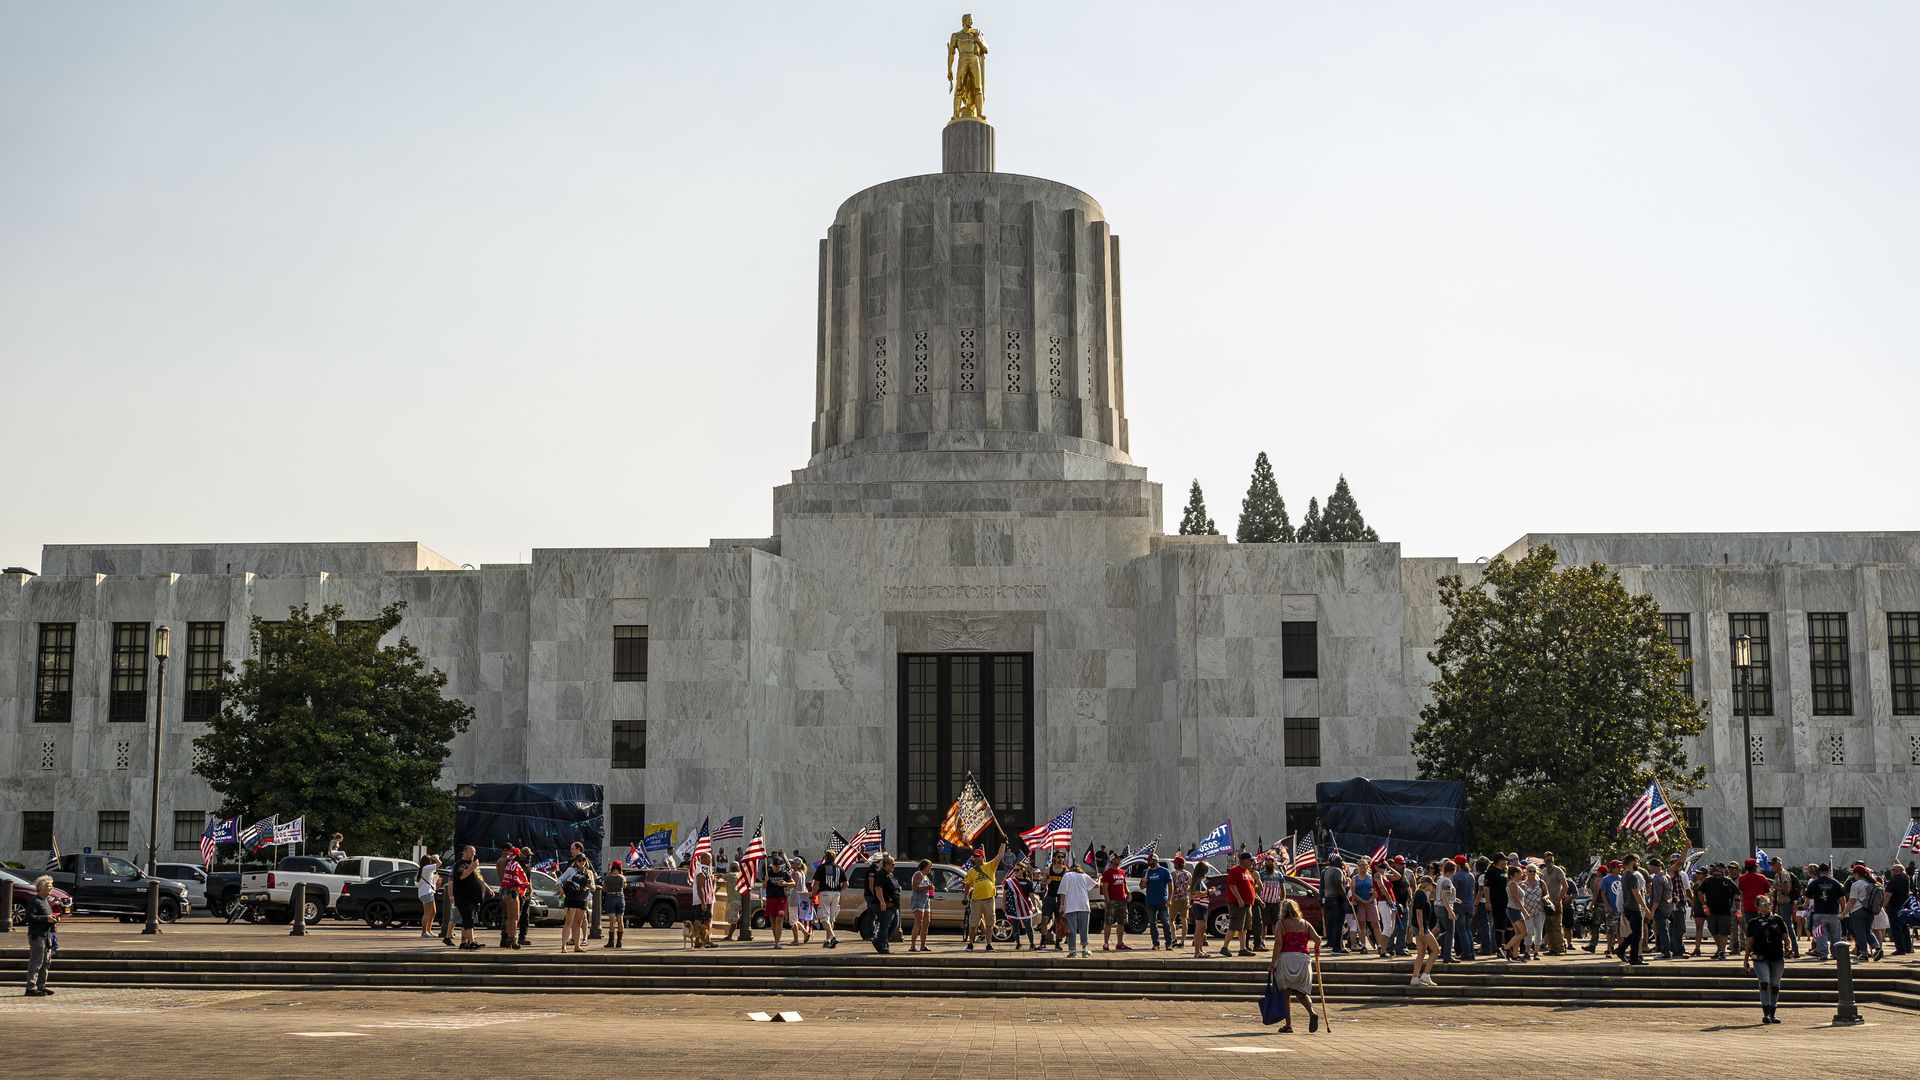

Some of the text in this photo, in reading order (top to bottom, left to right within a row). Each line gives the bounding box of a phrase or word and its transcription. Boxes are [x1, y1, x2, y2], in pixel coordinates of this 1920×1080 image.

[884, 585, 1047, 600] STATE OF OREGON
